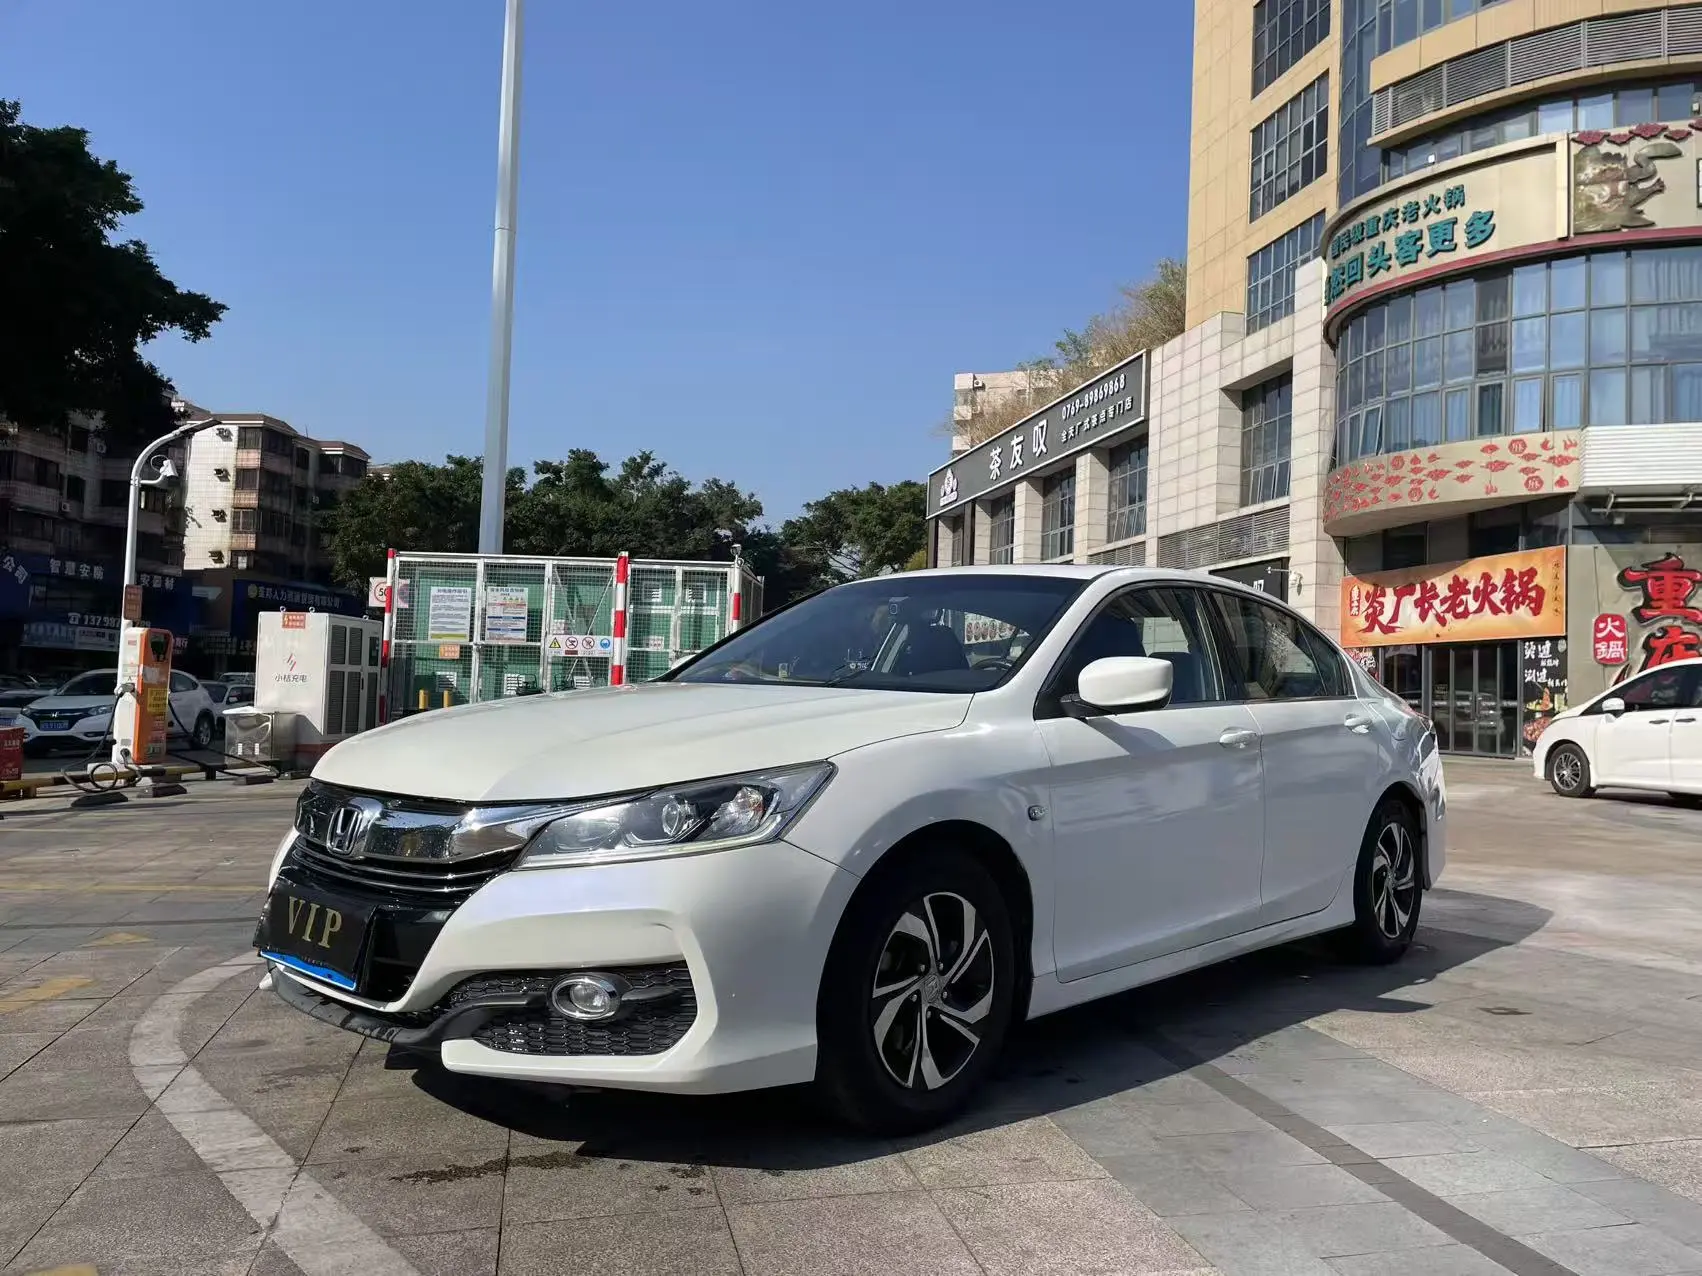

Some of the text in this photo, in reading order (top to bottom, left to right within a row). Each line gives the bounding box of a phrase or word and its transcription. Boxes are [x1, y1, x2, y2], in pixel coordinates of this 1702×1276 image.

[1061, 373, 1125, 419] 0769-89869868
[1359, 567, 1546, 634] 炎厂长老火锅
[1595, 617, 1625, 660] 火鍋
[274, 674, 308, 682] 小桔充电
[288, 896, 343, 949] VIP
